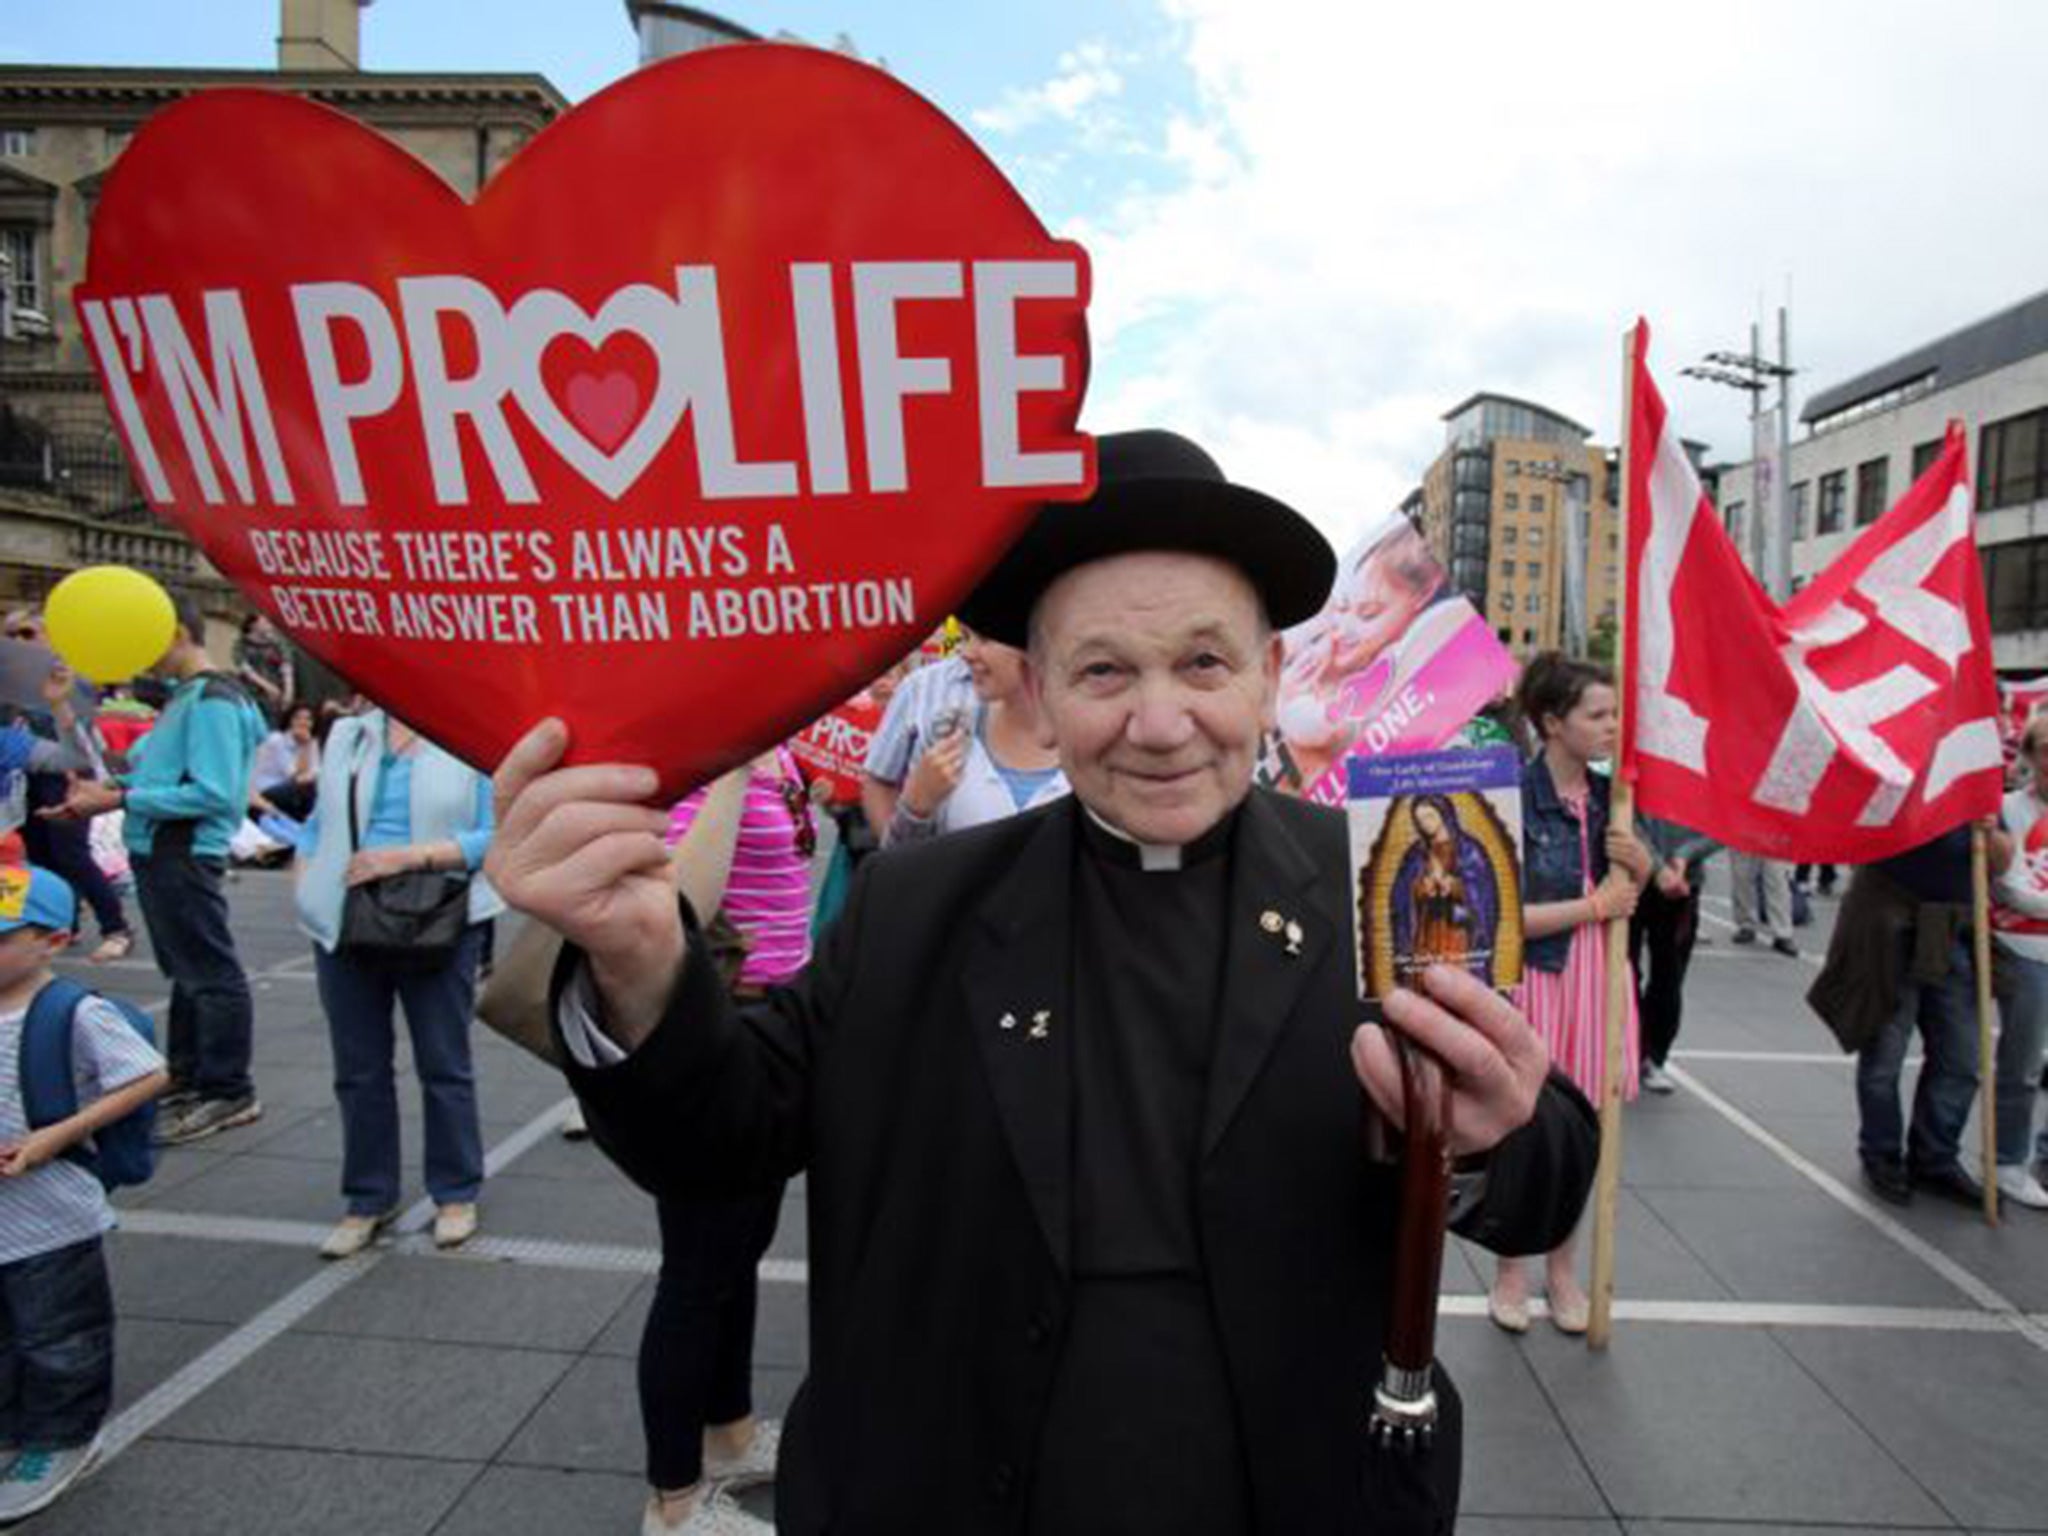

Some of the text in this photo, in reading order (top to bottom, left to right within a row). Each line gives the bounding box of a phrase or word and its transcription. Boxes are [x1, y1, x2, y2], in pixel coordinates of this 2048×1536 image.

[82, 289, 296, 506] I'M
[248, 523, 795, 582] BECAUSE THERE'S ALWAYS A
[270, 577, 915, 643] BETTER ANSWER THAN ABORTION
